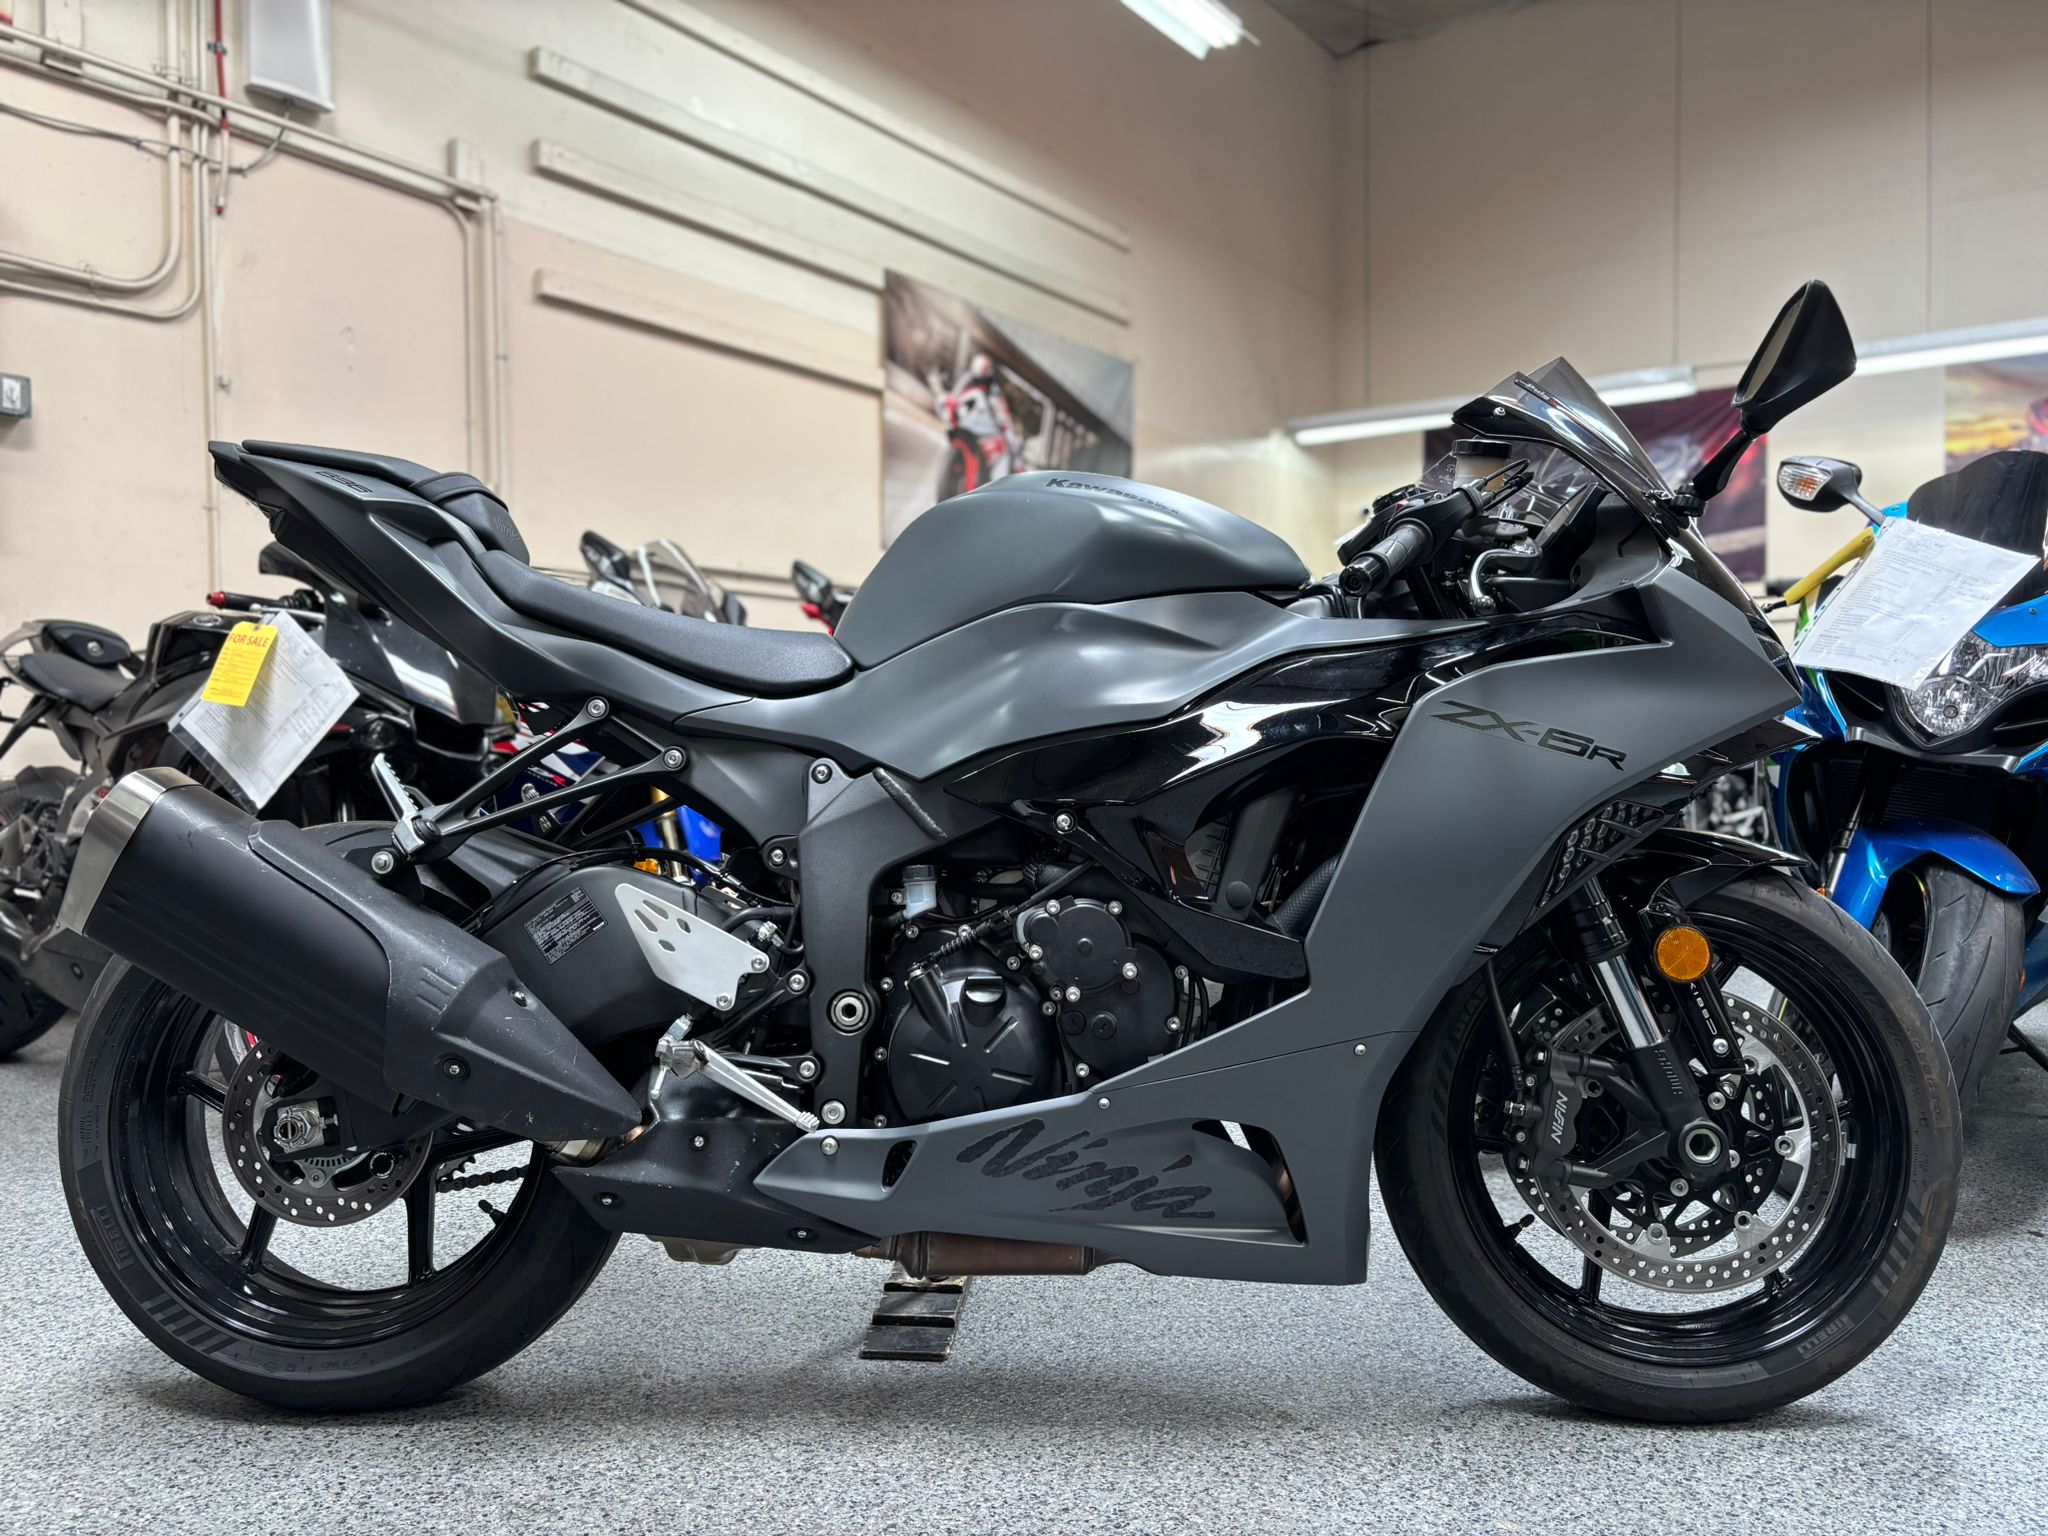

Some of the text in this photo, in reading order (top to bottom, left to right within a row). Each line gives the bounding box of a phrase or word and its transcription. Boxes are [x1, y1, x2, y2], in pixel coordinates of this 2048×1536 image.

[1046, 478, 1179, 515] Kawasaki
[228, 633, 270, 647] FOR SALE
[1430, 700, 1627, 771] ZX-6R
[956, 1118, 1216, 1219] Ninja
